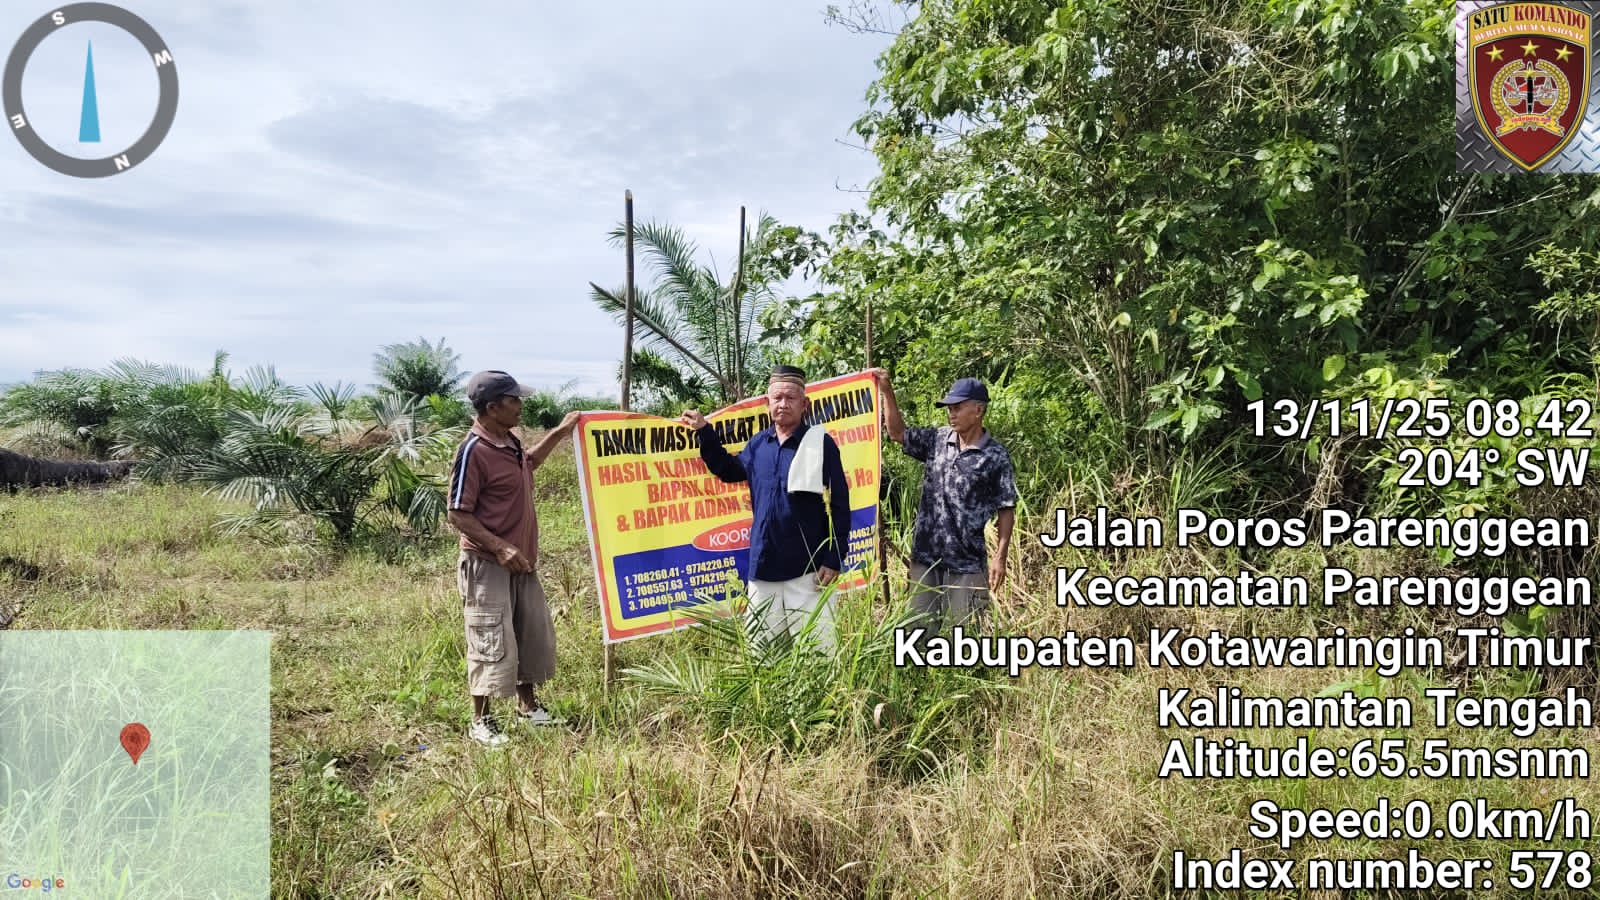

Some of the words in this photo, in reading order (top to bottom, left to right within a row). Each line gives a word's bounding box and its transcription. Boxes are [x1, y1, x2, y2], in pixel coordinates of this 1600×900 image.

[591, 428, 646, 458] TANAH
[650, 415, 756, 454] MASYAKAT
[828, 423, 875, 446] Group
[597, 460, 651, 486] HASIL
[853, 467, 874, 489] Ha
[646, 479, 703, 504] BAPAK
[616, 515, 631, 532] &
[633, 502, 692, 530] BAPAK
[694, 495, 742, 520] ADAM
[709, 527, 752, 548] KOOR
[624, 575, 633, 586] 1.
[632, 567, 680, 586] 708260.41
[626, 587, 636, 599] 2.
[628, 599, 638, 612] 3.
